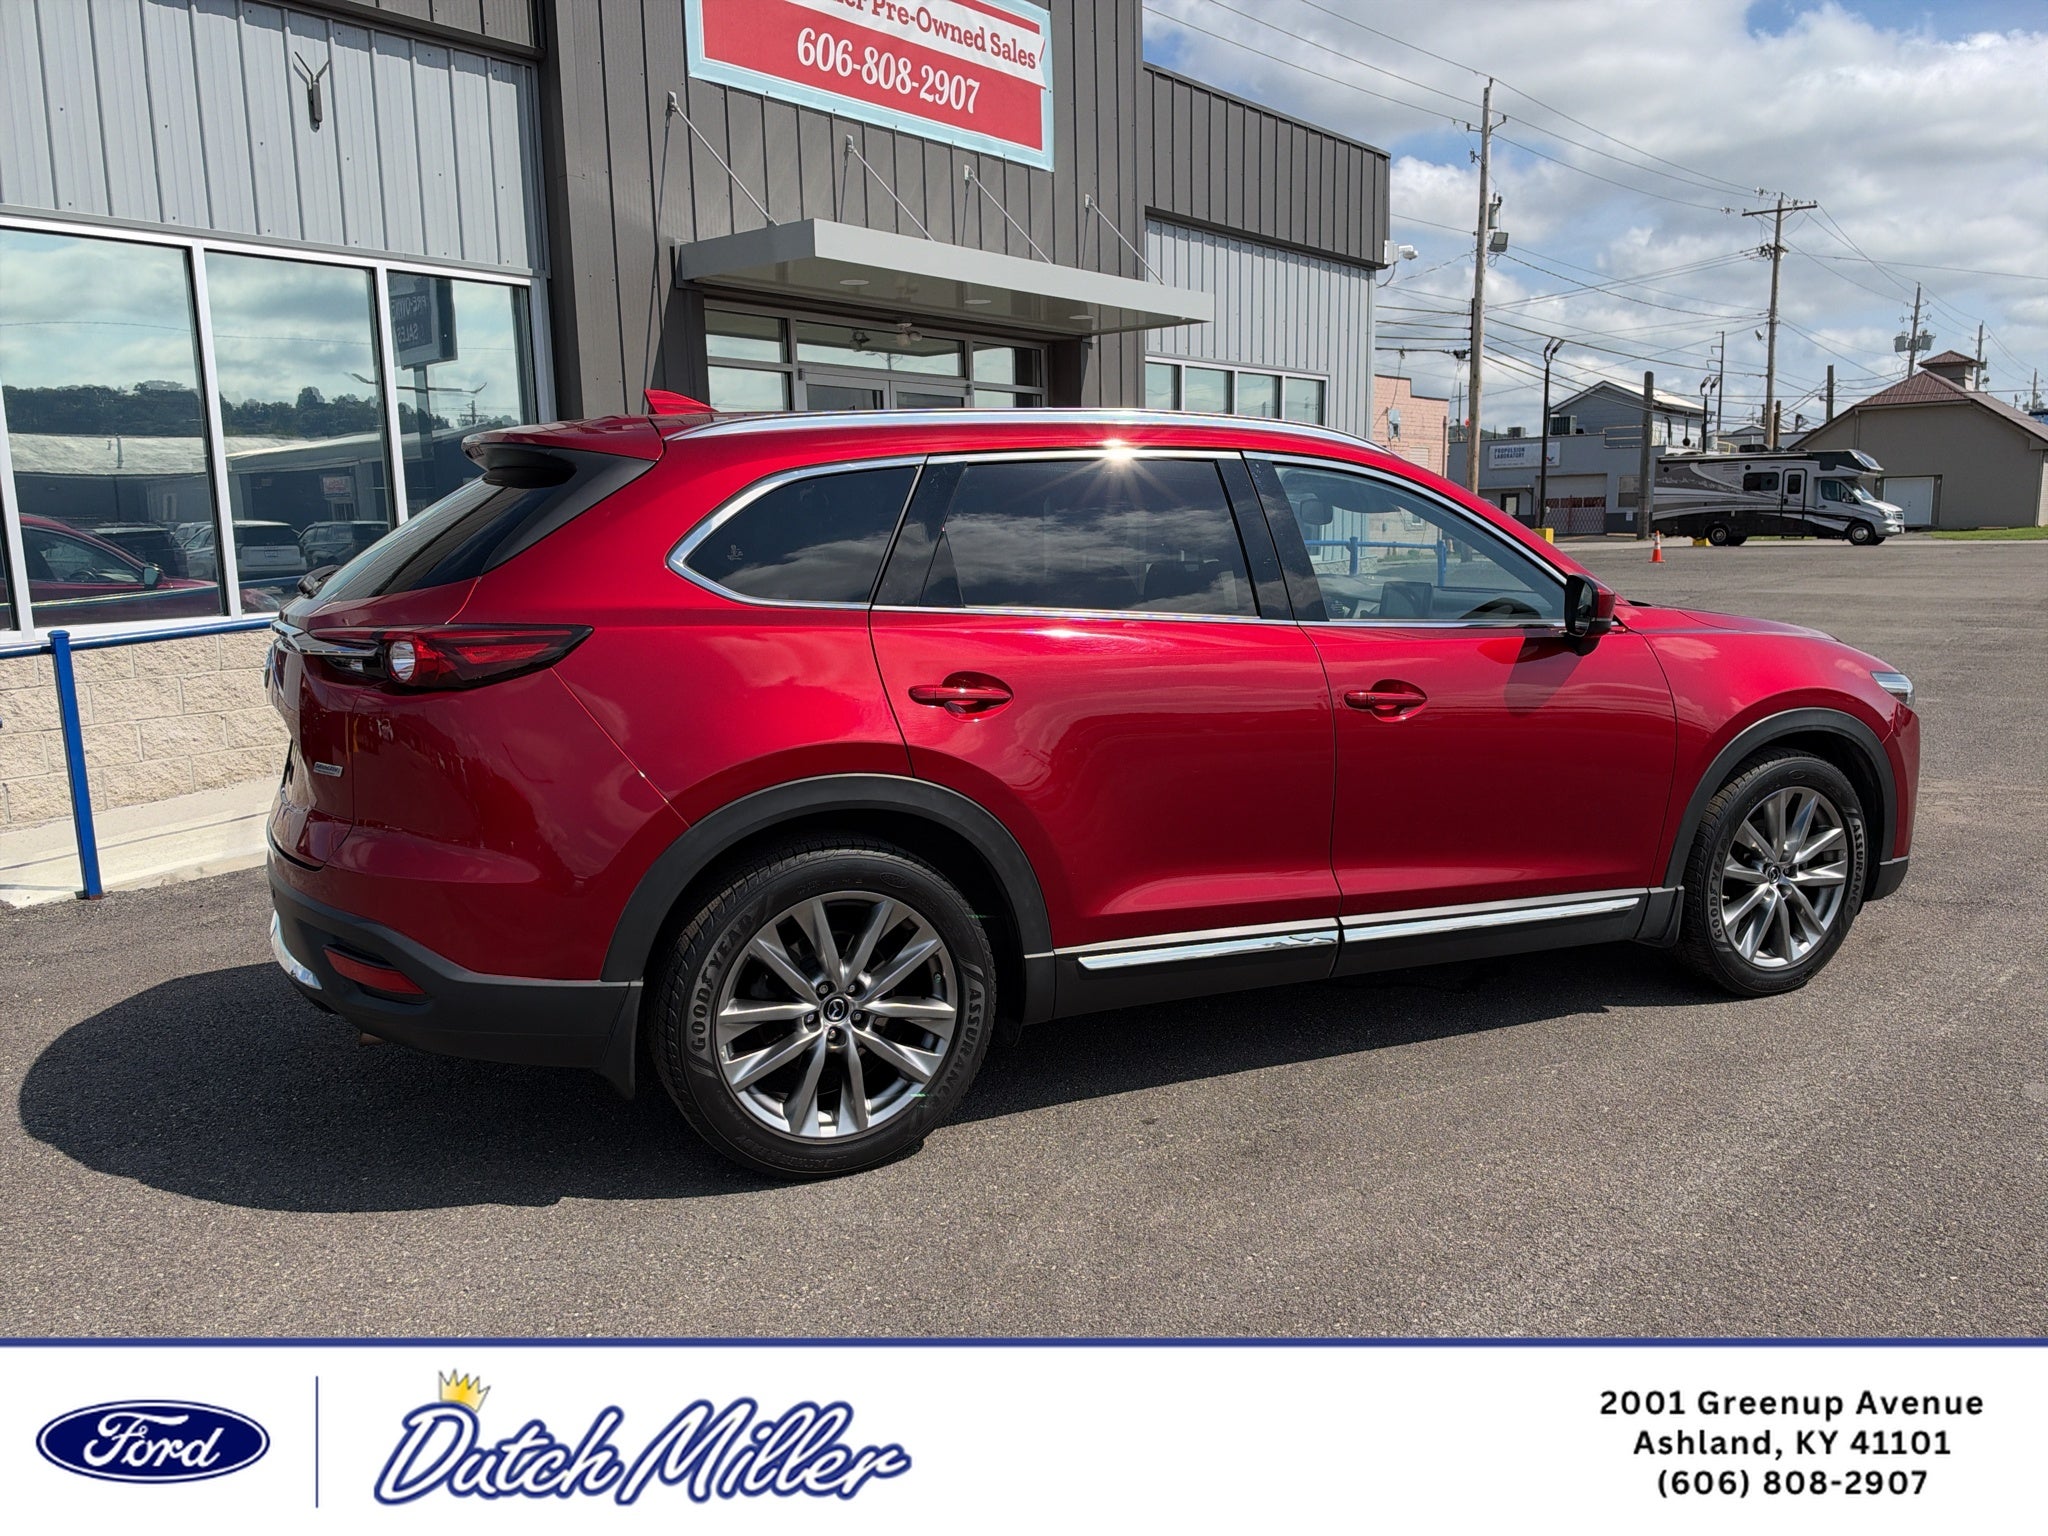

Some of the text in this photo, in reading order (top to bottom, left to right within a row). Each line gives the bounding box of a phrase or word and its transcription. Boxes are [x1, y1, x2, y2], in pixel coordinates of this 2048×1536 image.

[797, 27, 980, 114] 606-808-2907
[871, 0, 1036, 70] Pre-Owned Sales
[1709, 839, 1729, 939] GOODYEAR
[690, 914, 754, 1053] GOODYEAR
